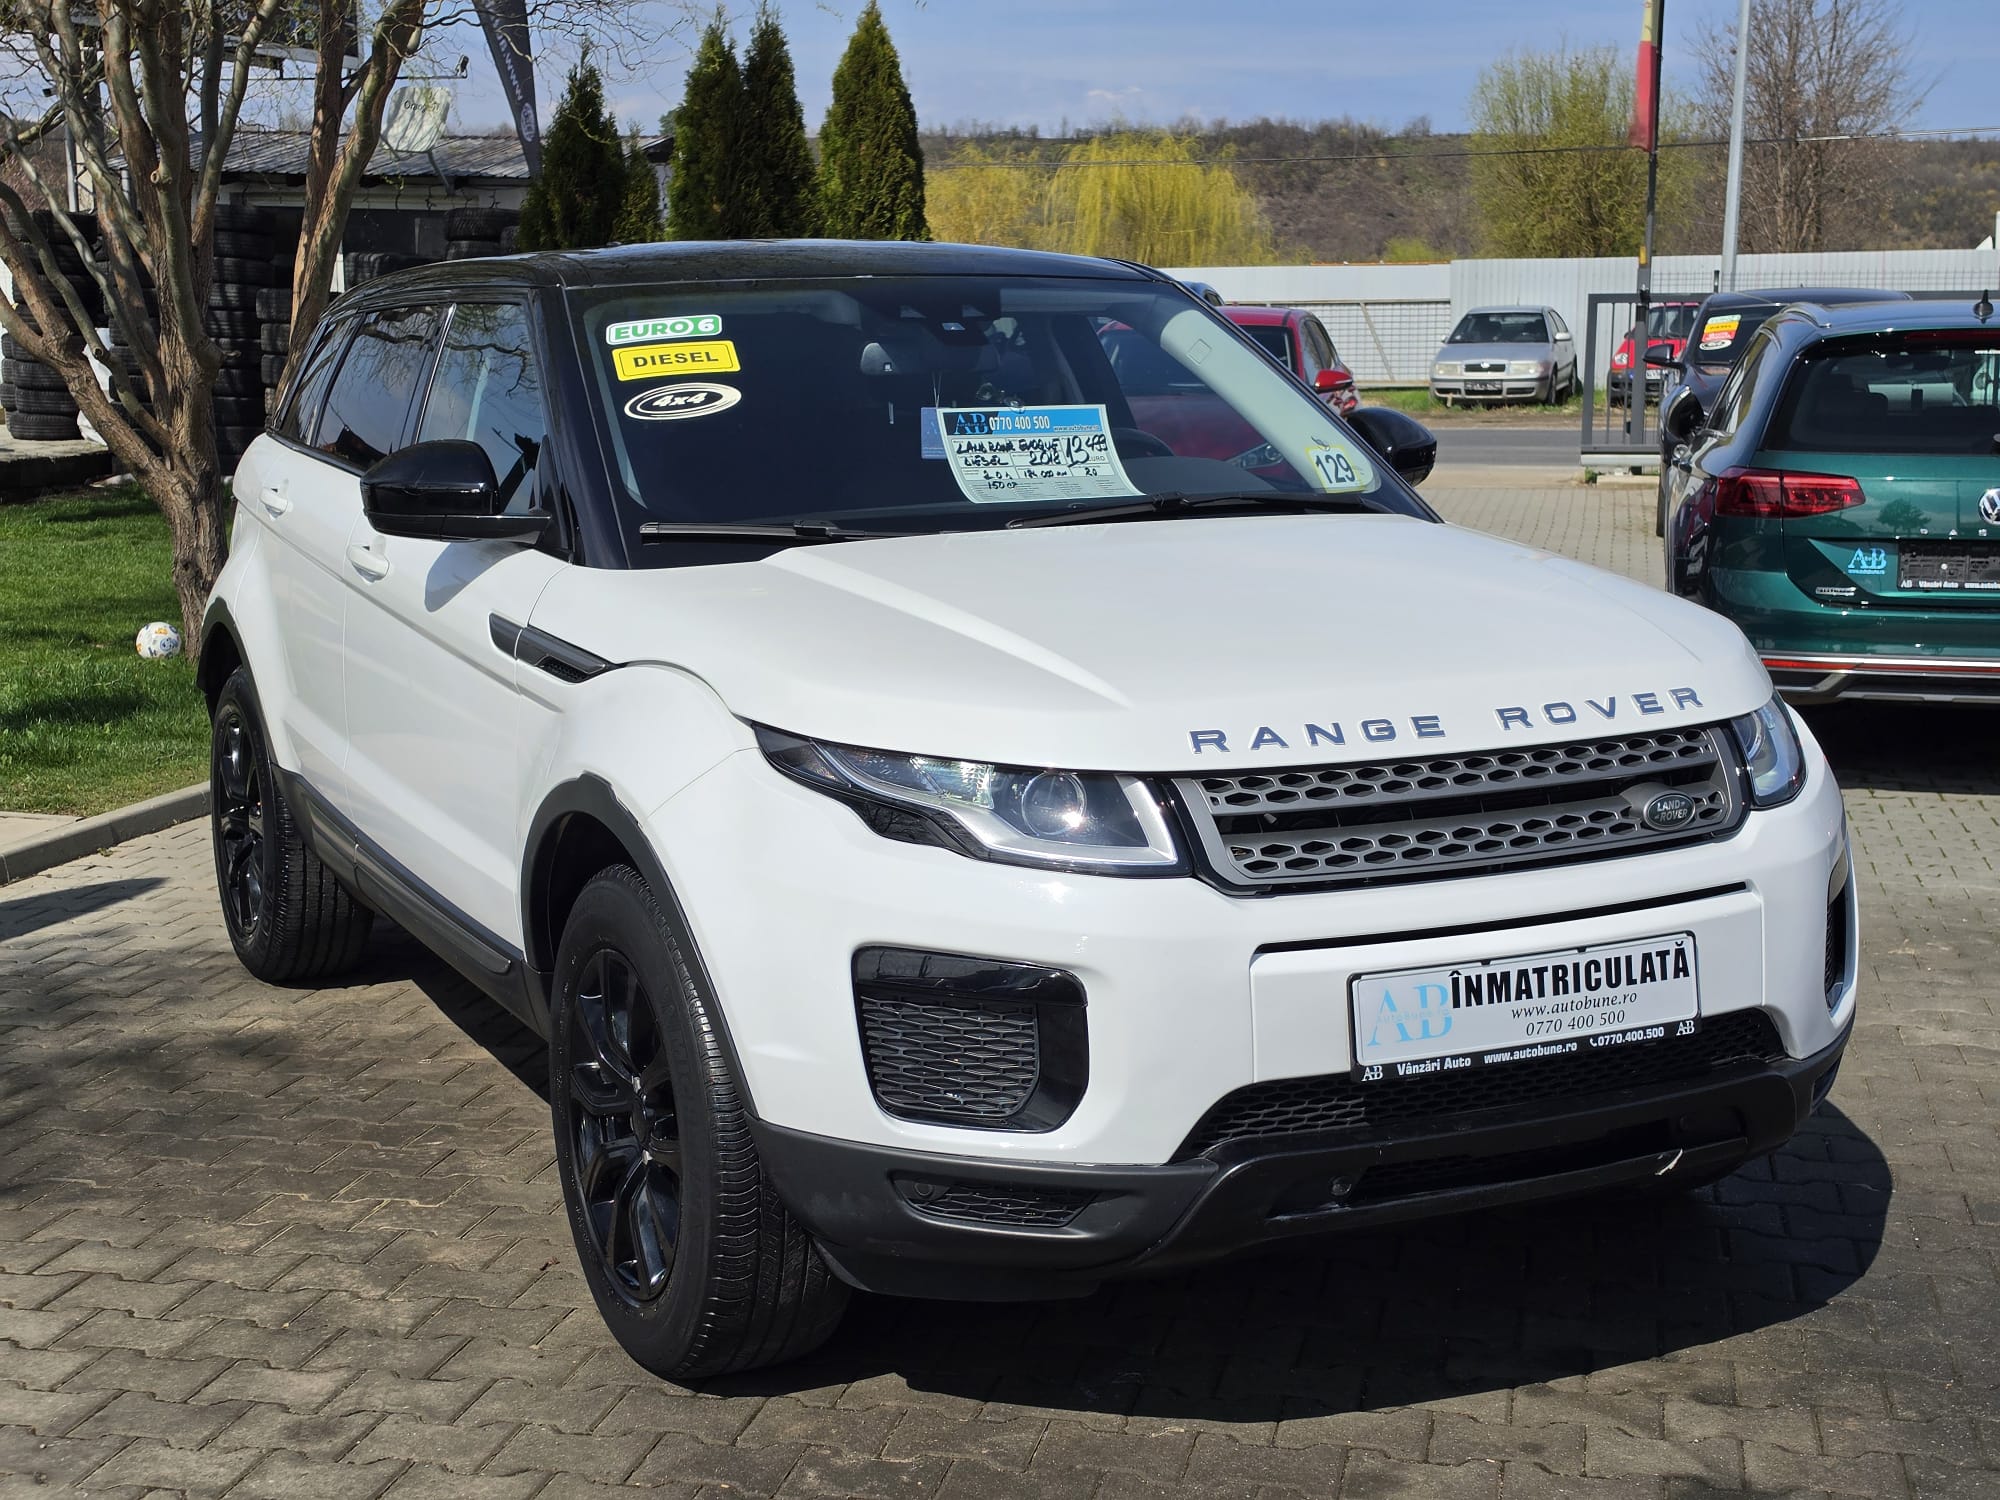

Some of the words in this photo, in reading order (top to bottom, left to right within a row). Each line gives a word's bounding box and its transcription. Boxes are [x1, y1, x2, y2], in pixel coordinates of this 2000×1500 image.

[614, 321, 689, 340] EURO
[698, 318, 714, 332] 6
[633, 351, 719, 368] DIESEL
[652, 392, 708, 407] 4x4
[989, 416, 1012, 431] 0770
[1014, 416, 1031, 430] 400
[1033, 415, 1050, 429] 500
[1315, 453, 1355, 484] 129
[1188, 715, 1446, 754] RANGE
[1493, 687, 1704, 731] ROVER
[1657, 800, 1680, 812] LAND
[1660, 809, 1688, 821] ROVER
[1448, 941, 1690, 1009] ÎNMATRICULATĂ
[1511, 992, 1637, 1019] www.autobune.ro
[1526, 1018, 1562, 1036] 0770
[1567, 1013, 1594, 1030] 400
[1600, 1009, 1625, 1026] 500
[1361, 1065, 1384, 1082] AB
[1397, 1058, 1440, 1076] Vânzări
[1444, 1056, 1471, 1070] Auto
[1484, 1042, 1577, 1064] www.autobune.ro
[1597, 1026, 1664, 1047] 0770.400.500
[1676, 1020, 1695, 1036] AB
